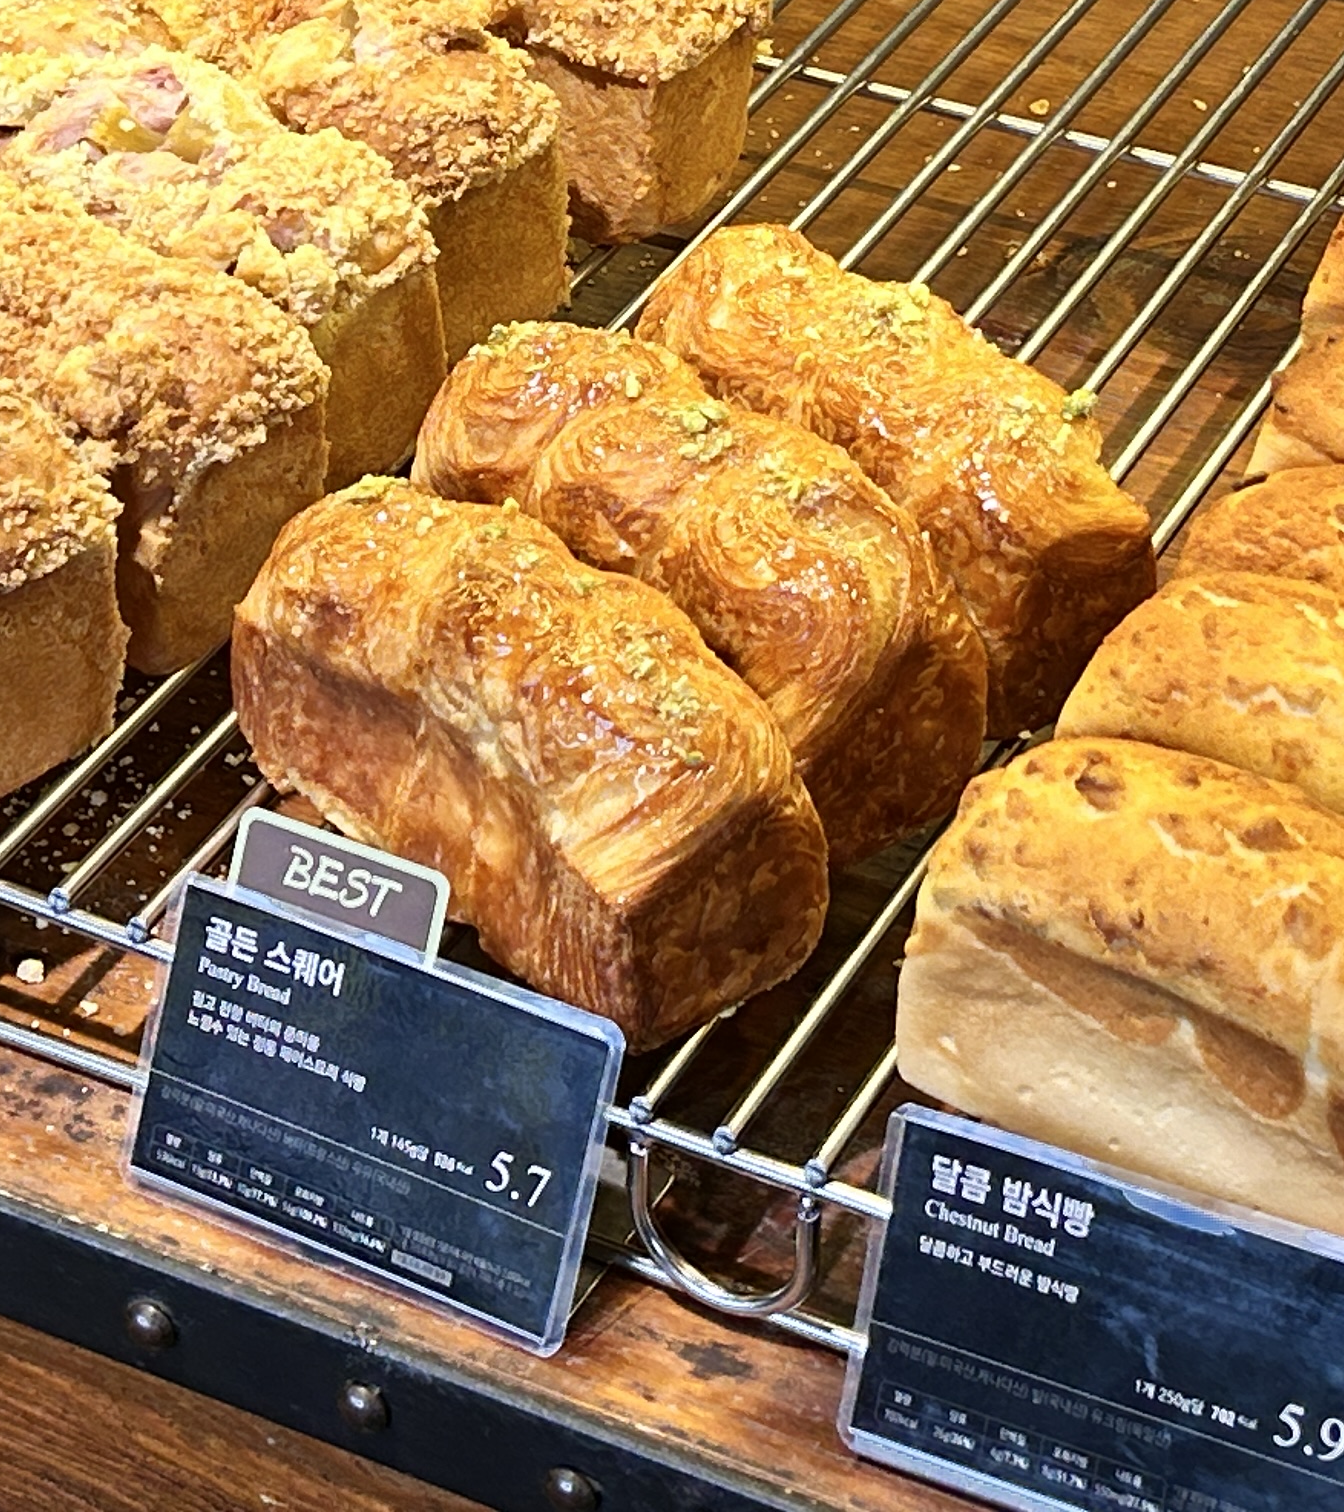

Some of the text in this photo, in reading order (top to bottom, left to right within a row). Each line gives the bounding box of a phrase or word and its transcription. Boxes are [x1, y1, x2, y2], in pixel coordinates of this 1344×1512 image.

[282, 845, 403, 918] BEST
[198, 956, 291, 1005] Pastry Bread
[205, 917, 346, 997] 골든 스퀘어
[485, 1151, 552, 1207] 5.7
[932, 1154, 1095, 1238] 달콤 밤식빵
[925, 1199, 1056, 1257] Chestnut Bread
[1136, 1379, 1156, 1399] 1개
